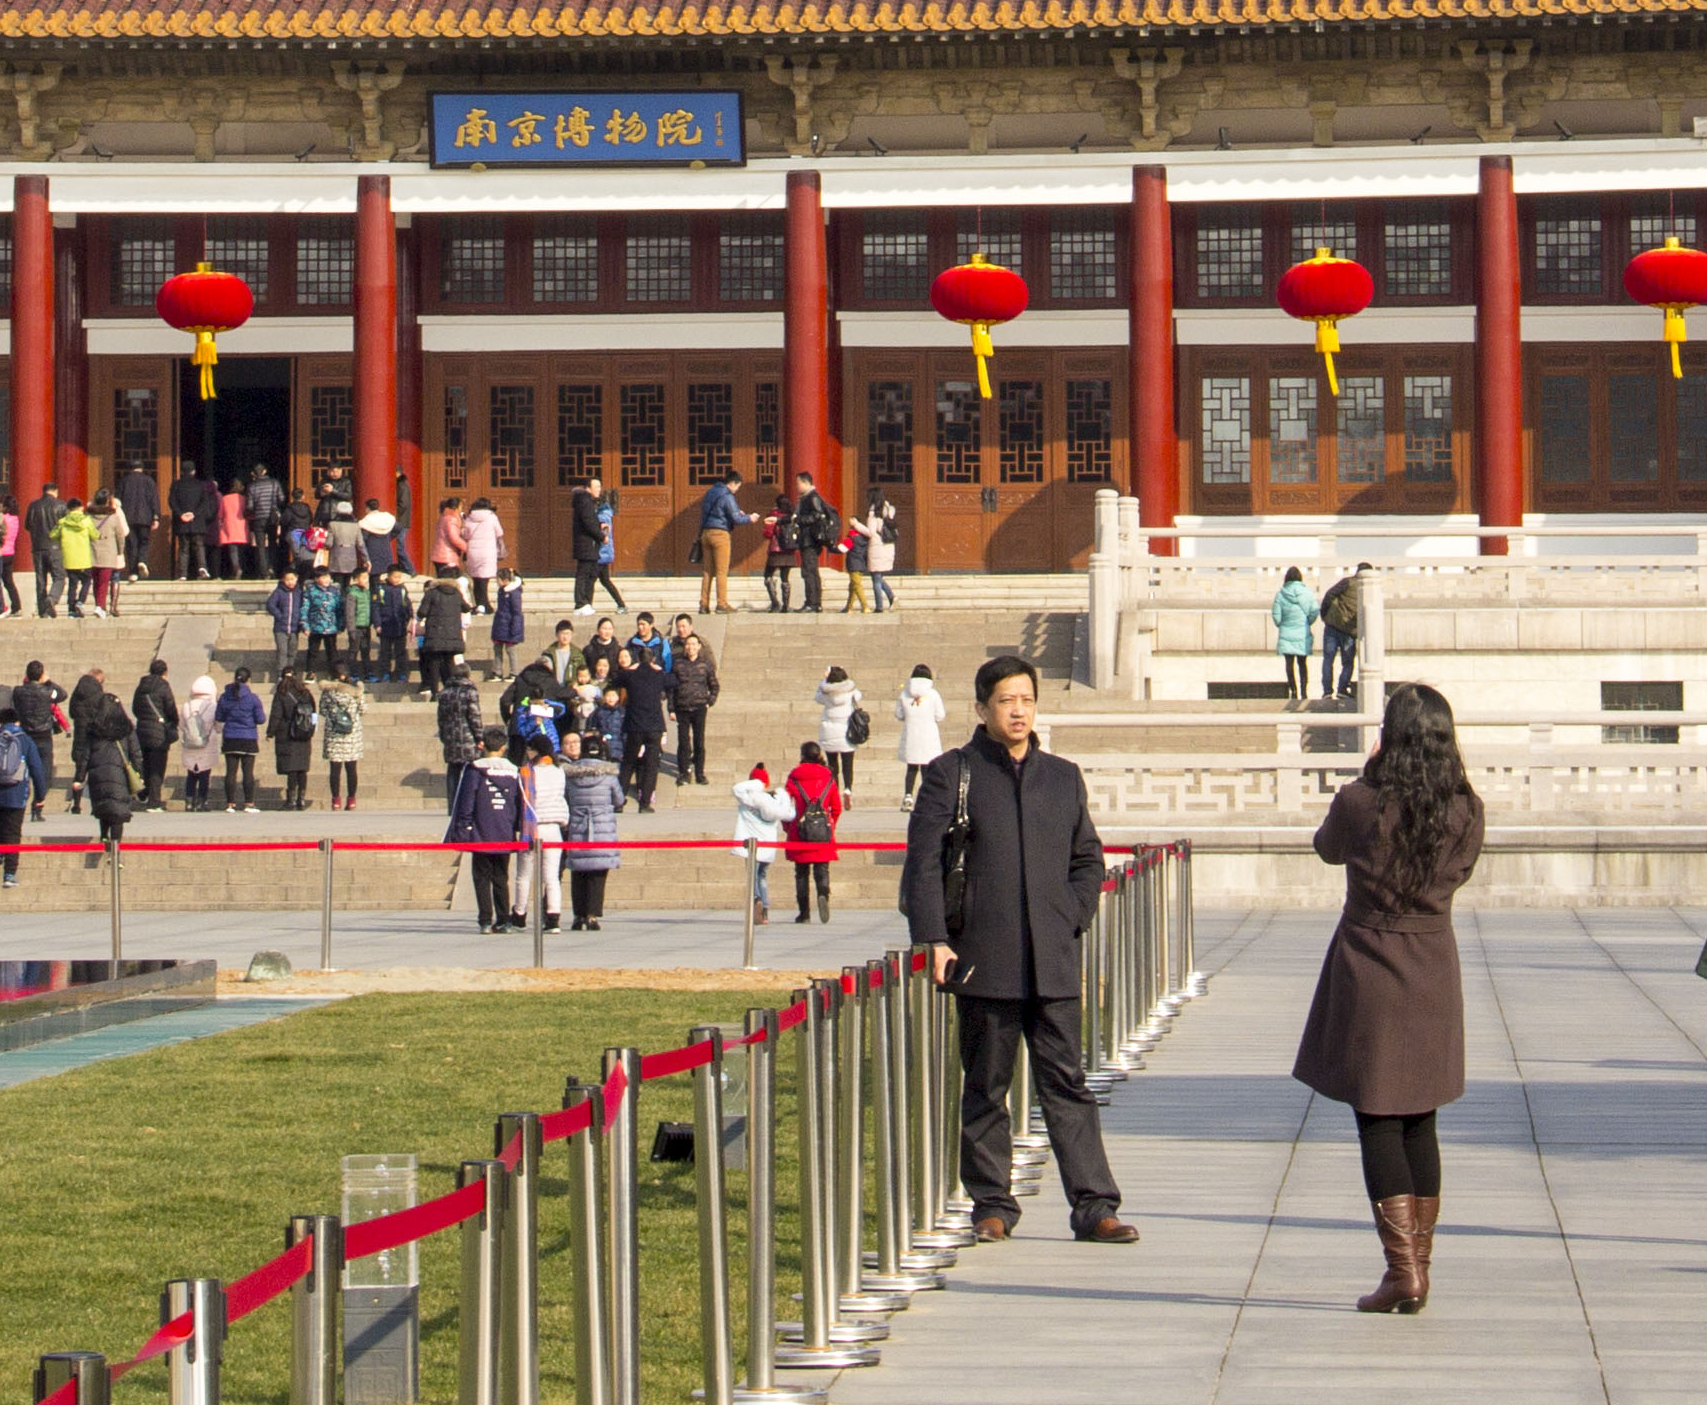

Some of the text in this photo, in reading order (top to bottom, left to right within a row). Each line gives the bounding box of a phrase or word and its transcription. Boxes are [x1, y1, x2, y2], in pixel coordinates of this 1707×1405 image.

[453, 105, 703, 150] 南京博物院
